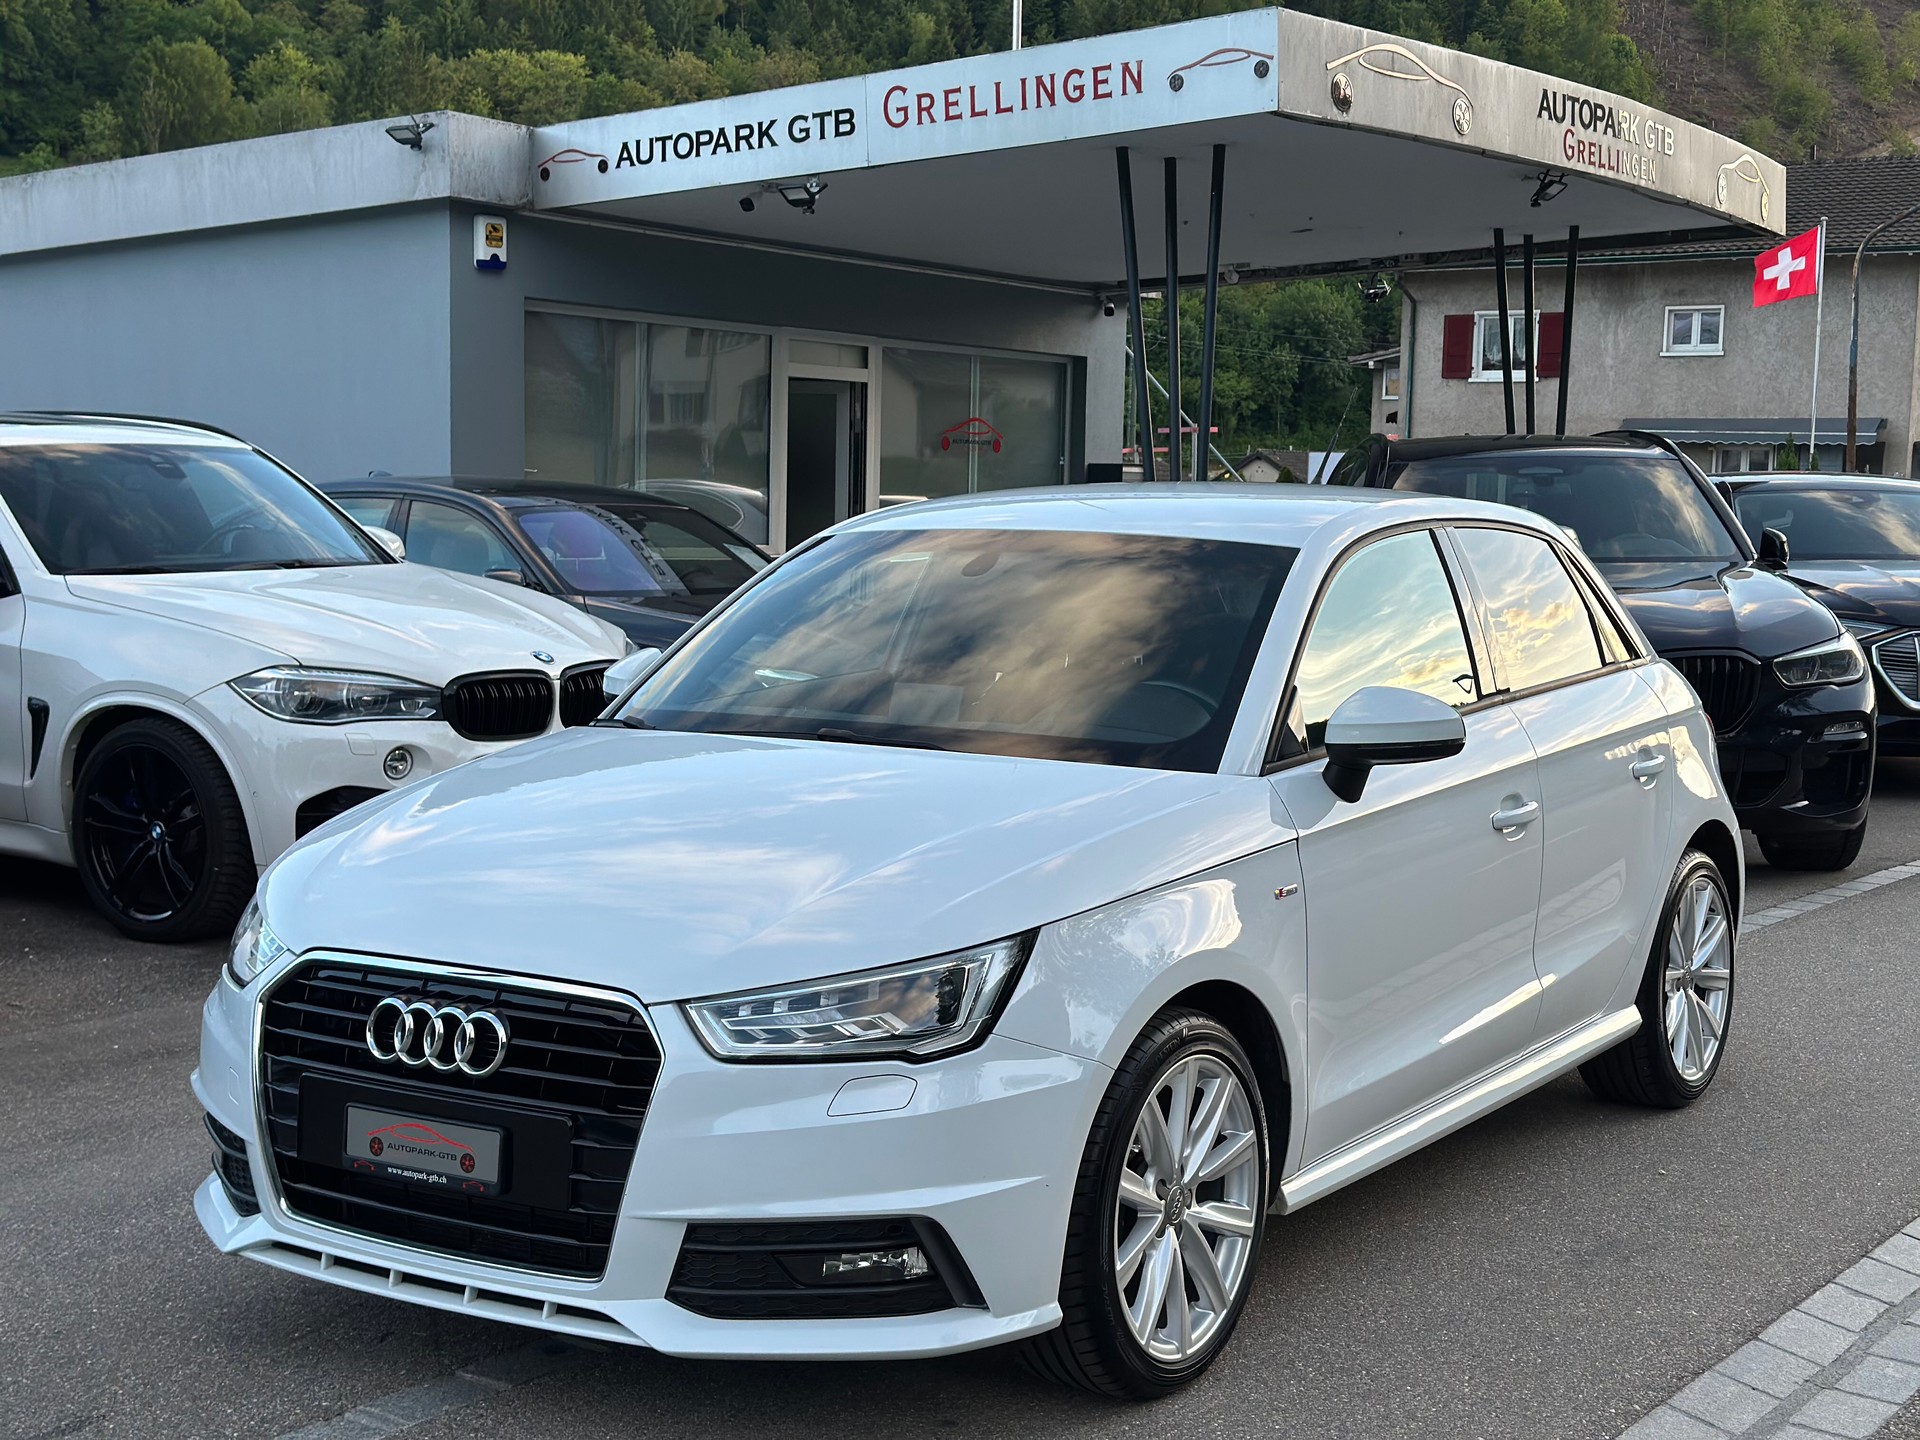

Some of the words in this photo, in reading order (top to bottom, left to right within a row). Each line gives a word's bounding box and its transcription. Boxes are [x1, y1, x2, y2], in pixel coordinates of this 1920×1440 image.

[615, 118, 779, 169] AUTOPARK
[787, 107, 856, 143] GTB
[883, 60, 1144, 129] GRELLINGEN
[1537, 88, 1640, 146] AUTOPARK
[1644, 119, 1675, 157] GTB
[1563, 128, 1657, 184] GRELLINGEN
[387, 1142, 458, 1162] AUTOPARK-GTB
[387, 1166, 447, 1184] www.autopark-gtb.ch
